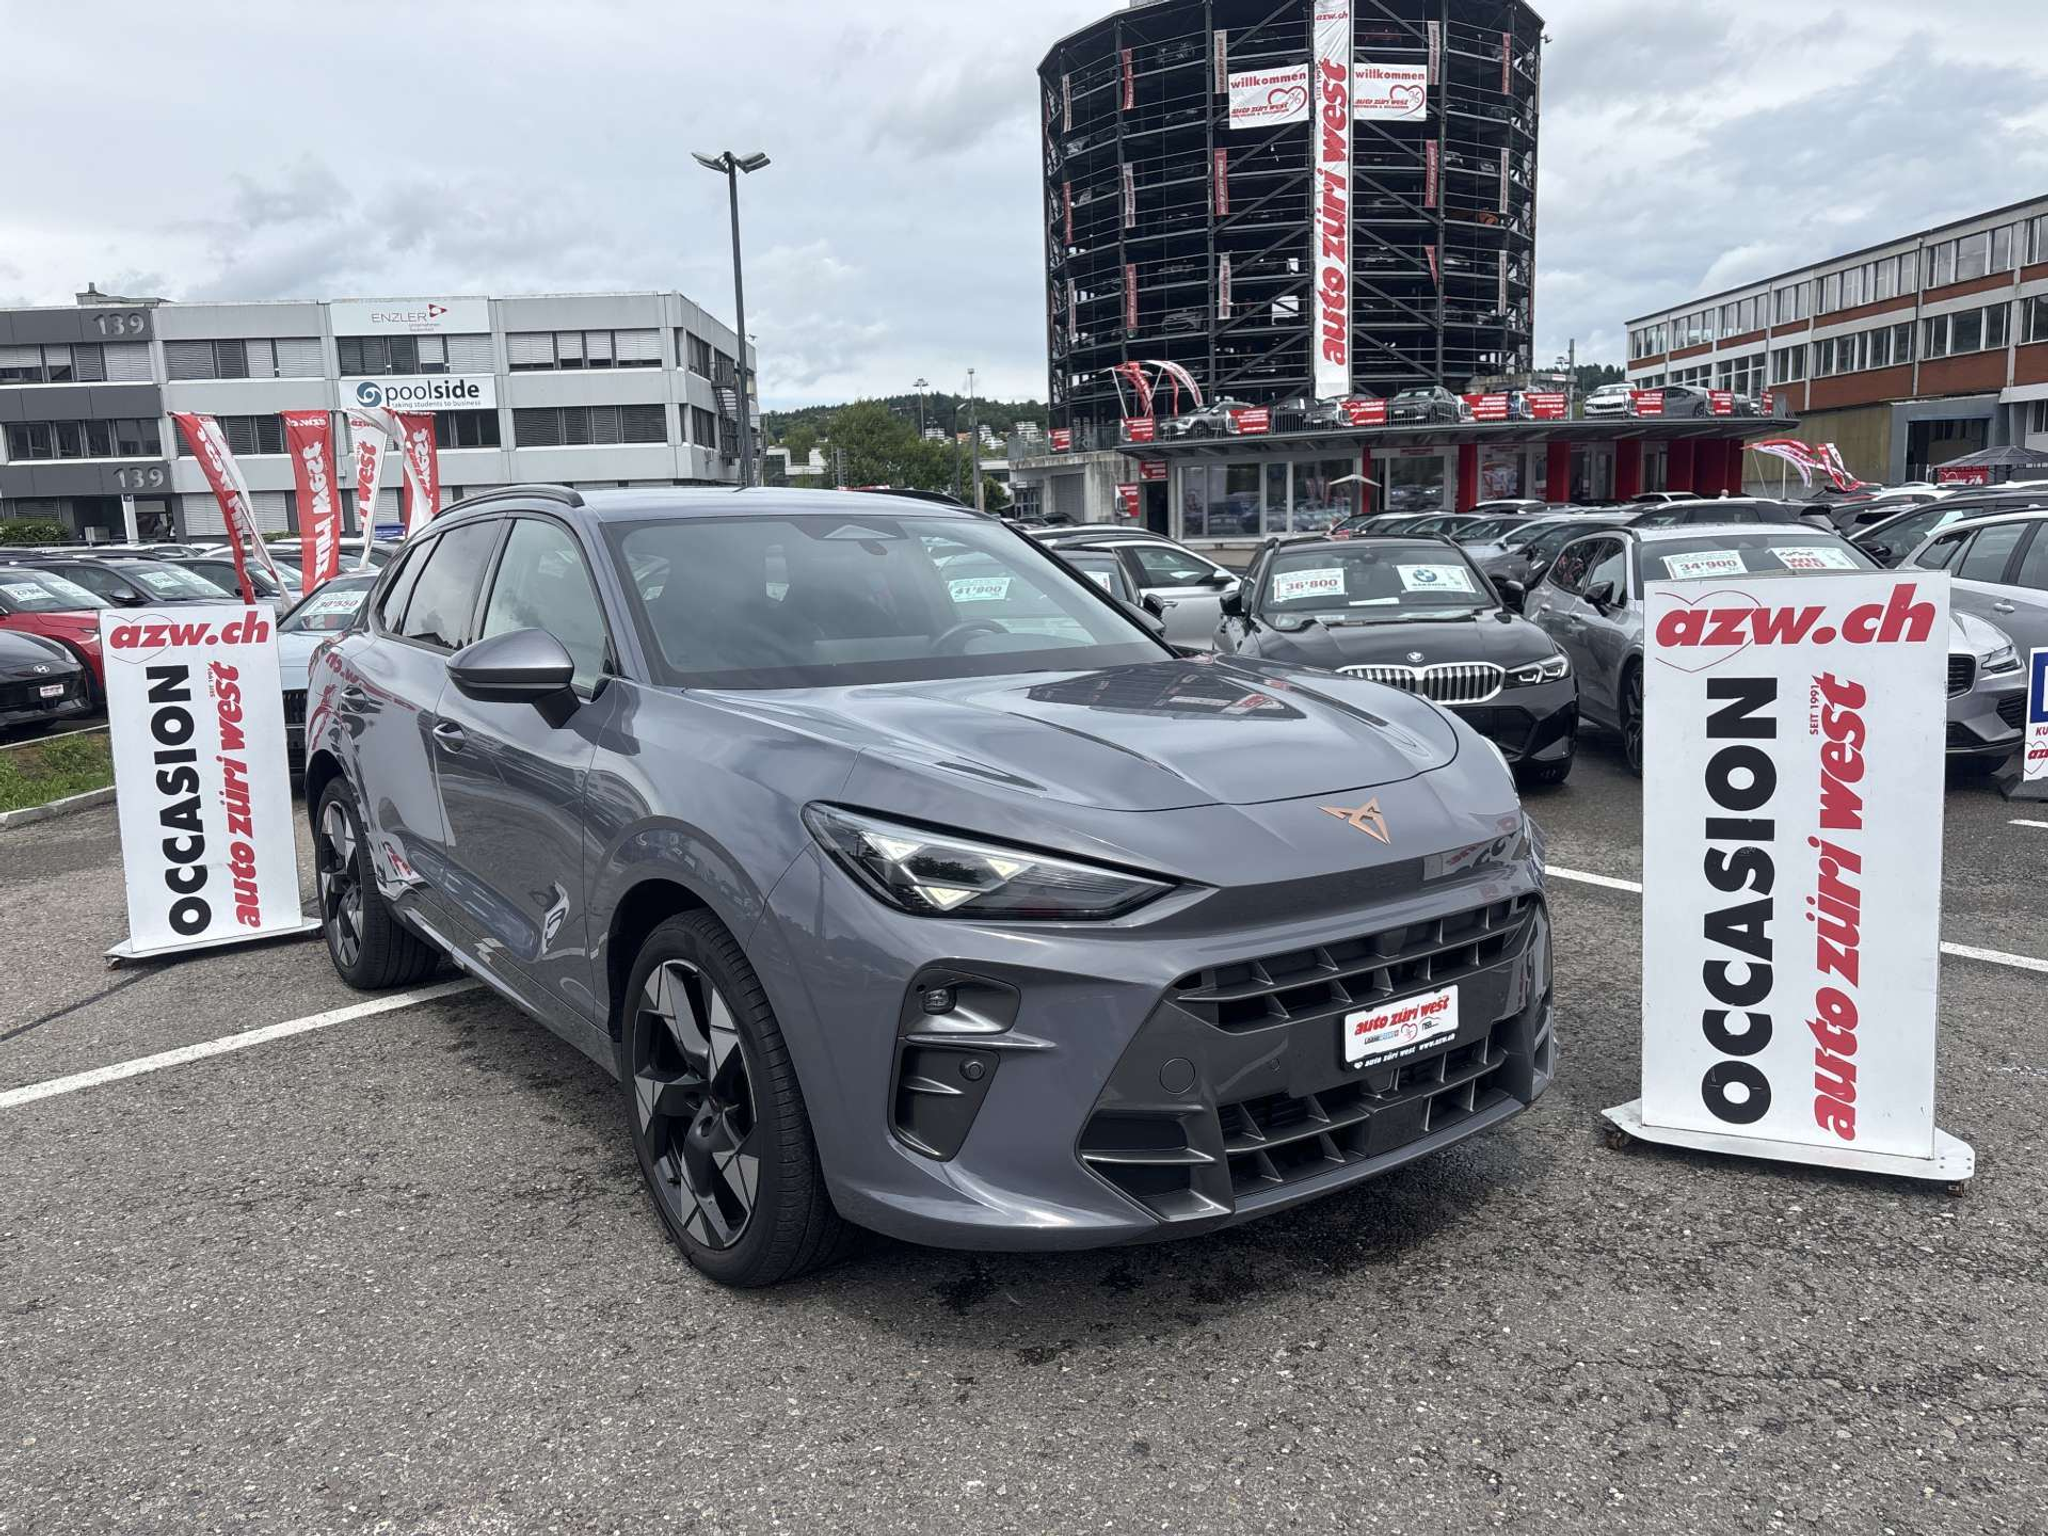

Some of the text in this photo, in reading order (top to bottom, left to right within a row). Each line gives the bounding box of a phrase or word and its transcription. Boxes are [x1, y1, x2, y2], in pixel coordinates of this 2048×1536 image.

[1230, 72, 1306, 88] willkommen
[1355, 69, 1425, 80] willkommen
[1316, 57, 1347, 366] auto züri west
[93, 313, 145, 335] 139
[371, 311, 427, 323] ENZLER
[385, 379, 480, 403] poolside
[414, 399, 443, 407] students
[453, 399, 481, 407] business
[113, 466, 164, 488] 139
[358, 441, 377, 501] west
[1285, 579, 1338, 590] 36'800
[109, 611, 269, 649] azw.ch
[1655, 583, 1937, 647] azw.ch
[1809, 684, 1820, 735] SEIT 1991
[145, 664, 212, 936] OCCASION
[208, 660, 261, 928] auto züri west
[1701, 677, 1777, 1124] OCCASION
[1805, 671, 1867, 1141] auto züri west
[1354, 1015, 1389, 1036] auto
[1389, 1004, 1420, 1027] züri
[1420, 995, 1450, 1018] west
[1365, 1056, 1382, 1067] auto
[1400, 1046, 1416, 1057] west
